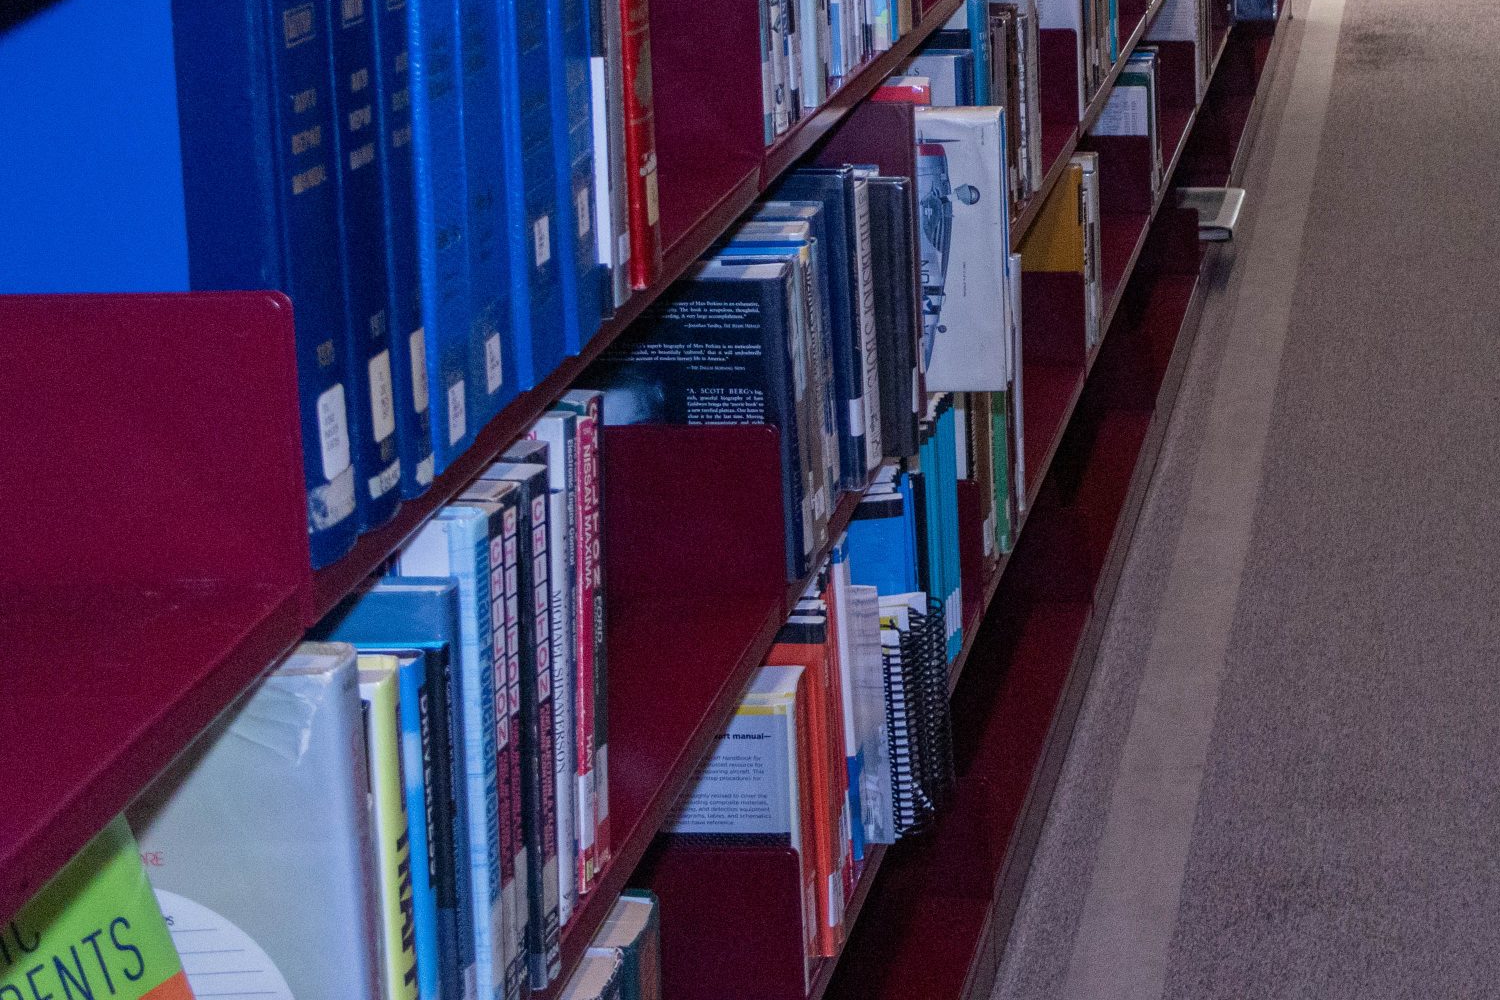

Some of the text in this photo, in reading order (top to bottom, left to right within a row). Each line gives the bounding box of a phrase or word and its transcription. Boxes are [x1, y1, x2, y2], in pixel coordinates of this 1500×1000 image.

[566, 438, 574, 485] Electronic
[583, 443, 593, 589] NISSAN MAXIMA
[491, 543, 507, 748] CHILTON
[505, 511, 519, 711] CHILTON
[534, 501, 550, 696] CHILTON
